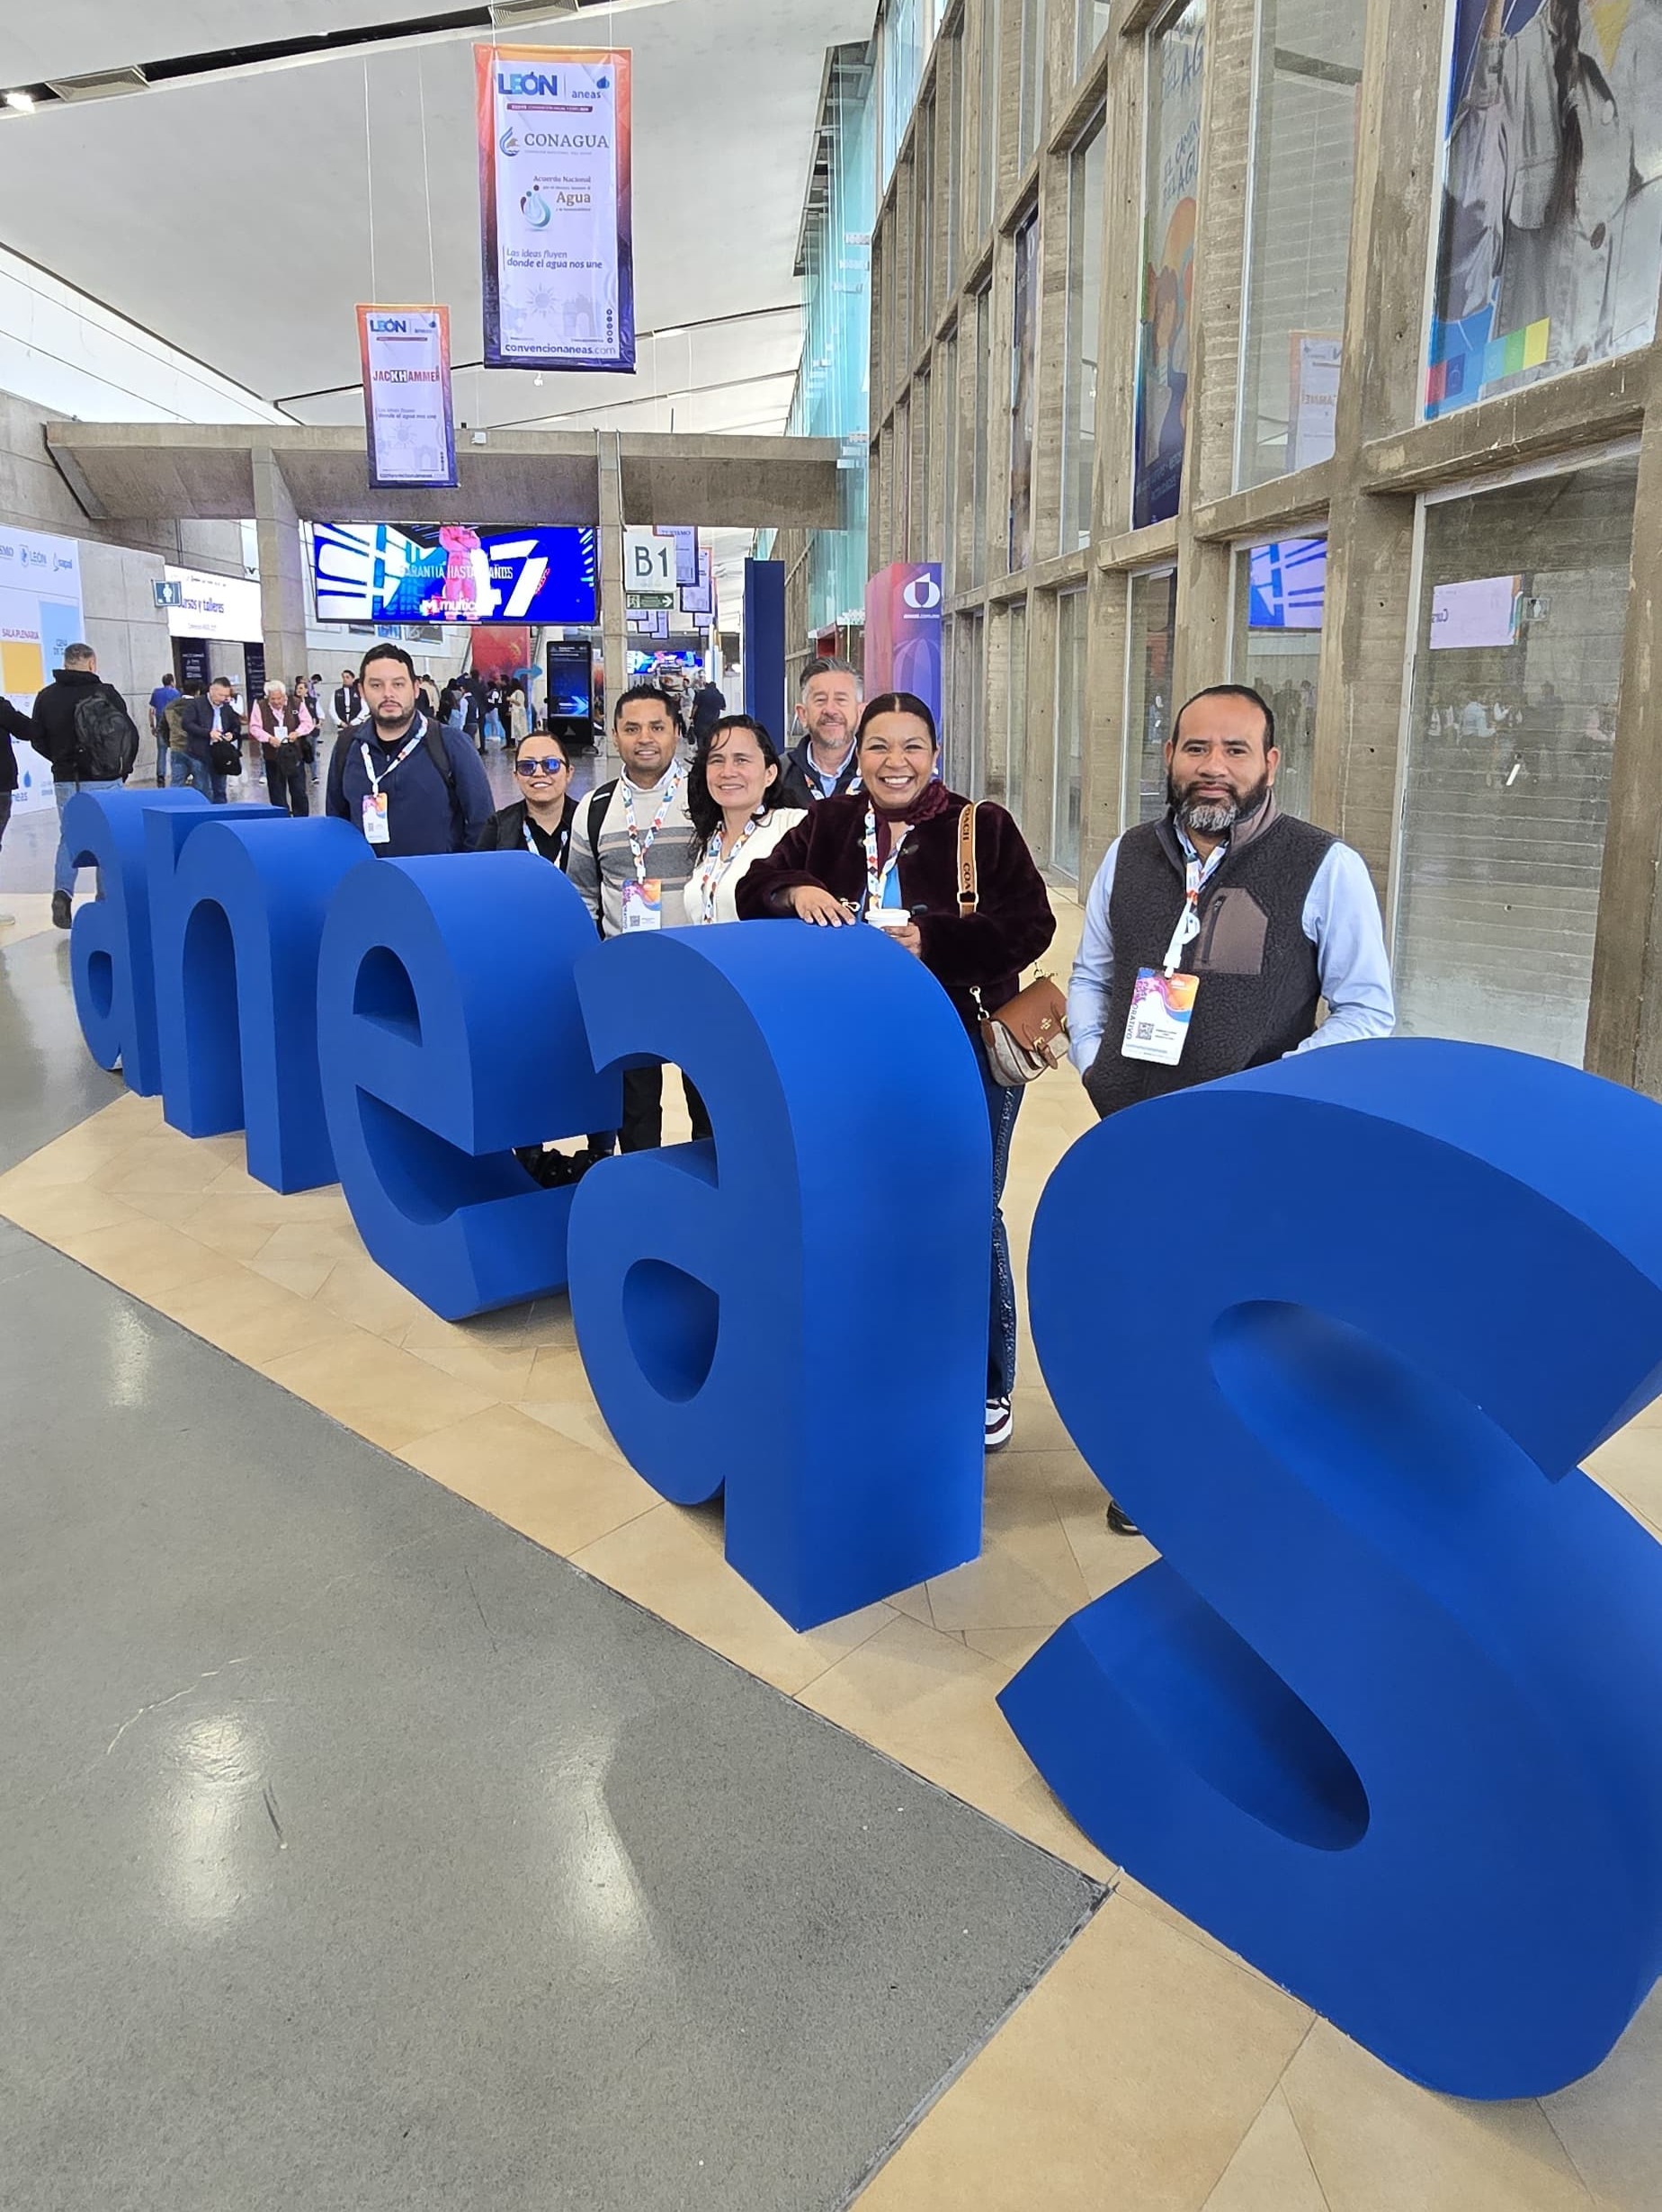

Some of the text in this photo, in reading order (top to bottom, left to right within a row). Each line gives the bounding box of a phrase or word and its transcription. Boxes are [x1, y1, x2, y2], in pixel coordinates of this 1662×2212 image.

[498, 72, 602, 99] LEÓN aneas
[524, 133, 610, 148] CONAGUA
[563, 175, 591, 183] Nacional
[556, 192, 591, 206] Agua
[506, 248, 567, 261] Las ideas fluyen
[507, 257, 534, 268] donde
[536, 259, 544, 268] el
[546, 261, 567, 270] agua
[569, 261, 585, 269] nos
[370, 318, 407, 333] LEÓN
[505, 343, 616, 355] convencionaneas.com
[635, 545, 668, 577] B1
[179, 597, 197, 611] ursos
[962, 807, 971, 841] OACH
[962, 862, 971, 889] COA
[67, 785, 1662, 2101] aneas
